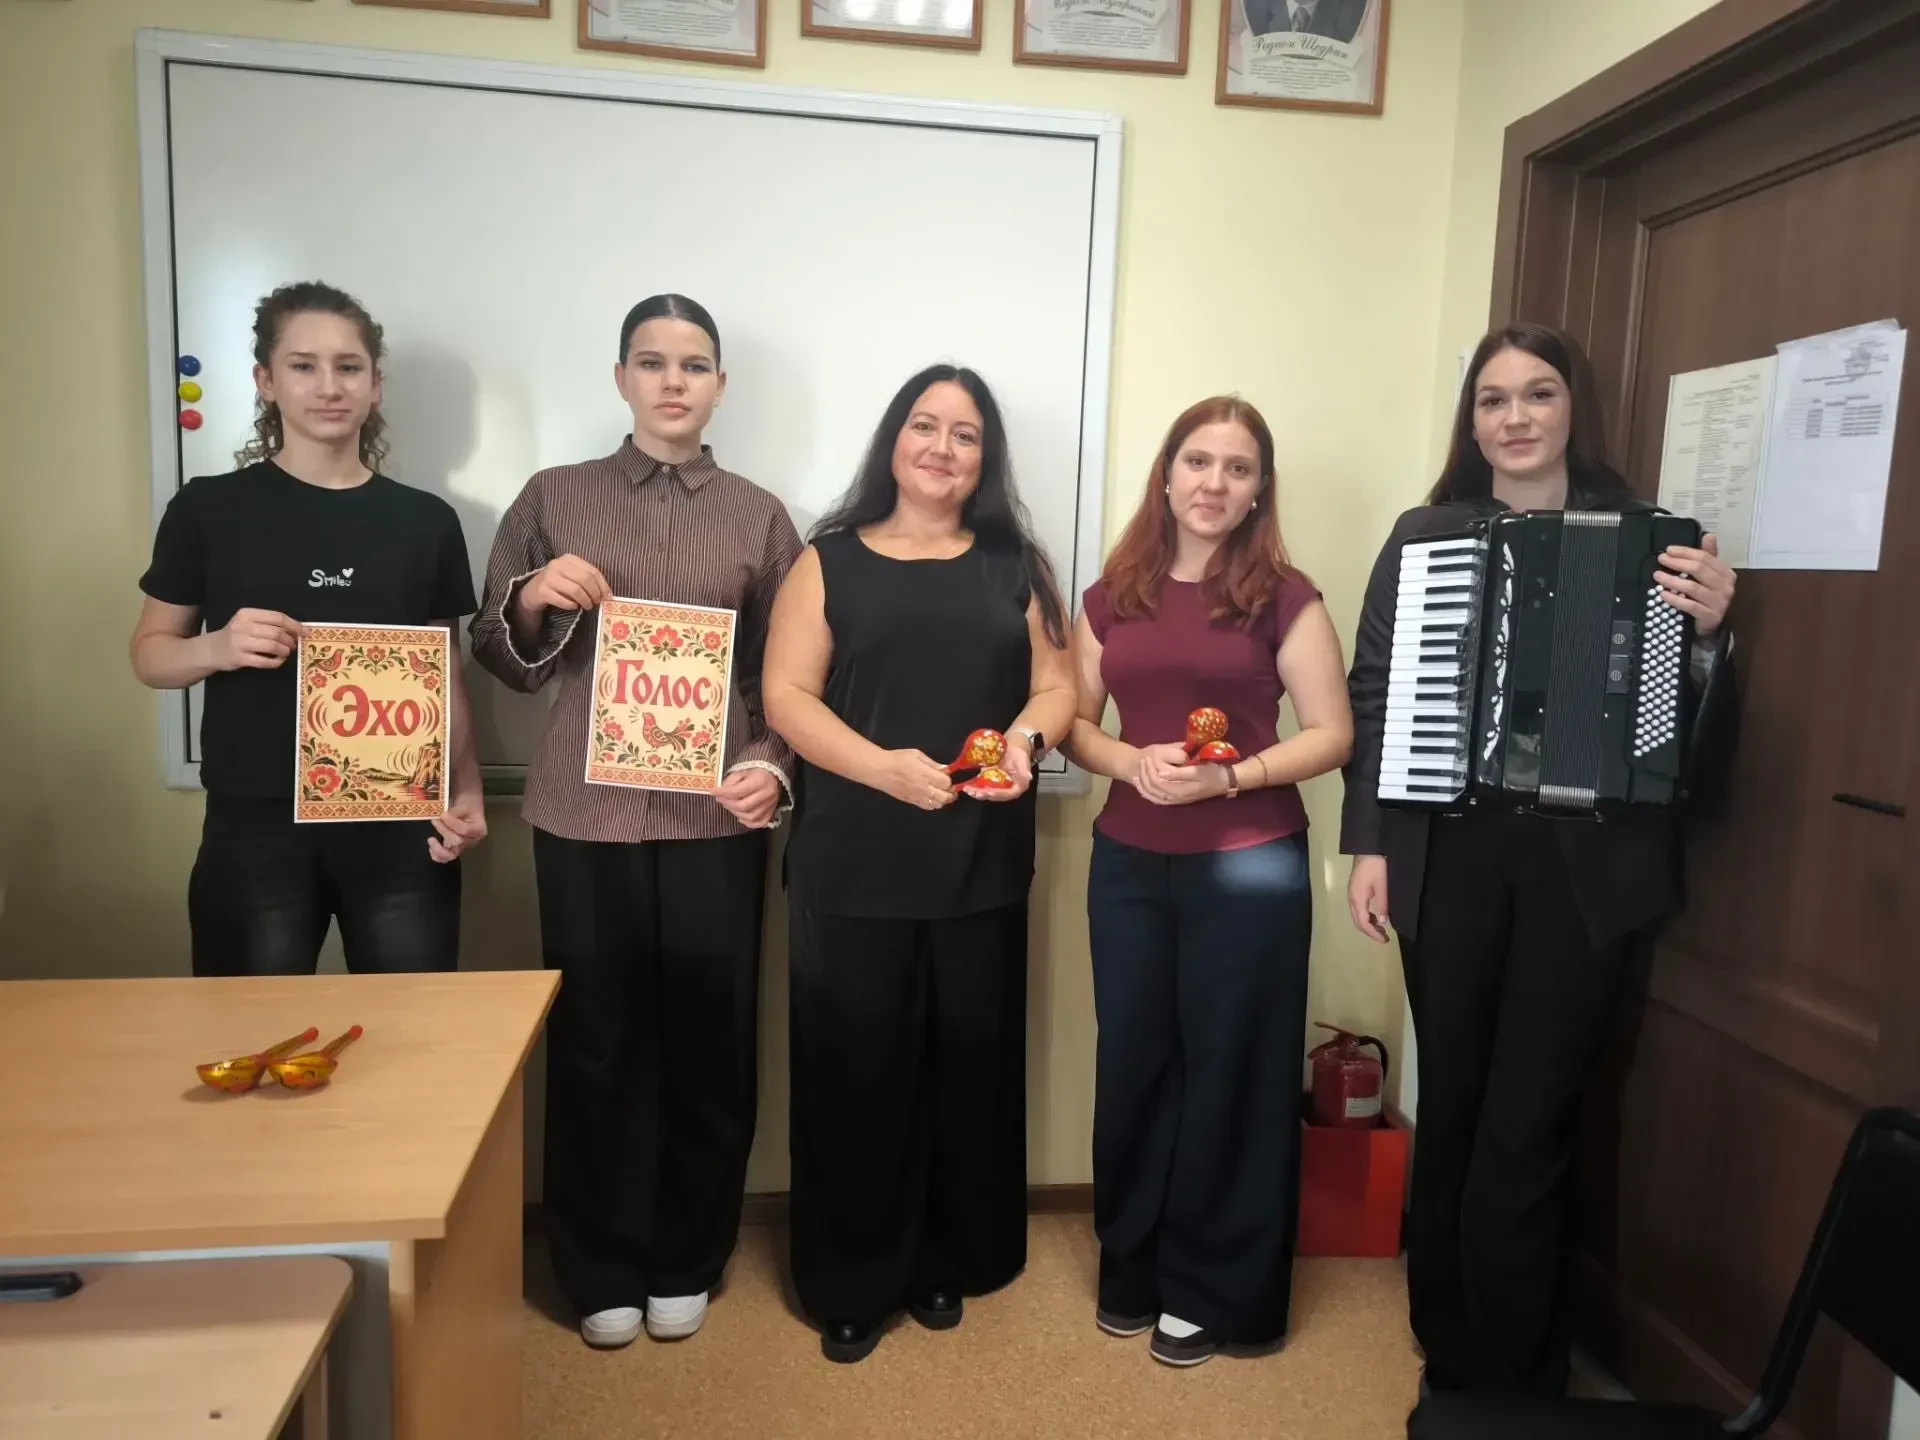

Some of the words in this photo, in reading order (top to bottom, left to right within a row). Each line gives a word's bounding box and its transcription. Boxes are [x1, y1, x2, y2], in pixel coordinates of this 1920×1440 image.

[1298, 34, 1349, 59] Щедрин
[612, 659, 712, 710] Голос
[331, 684, 421, 738] Эхо
